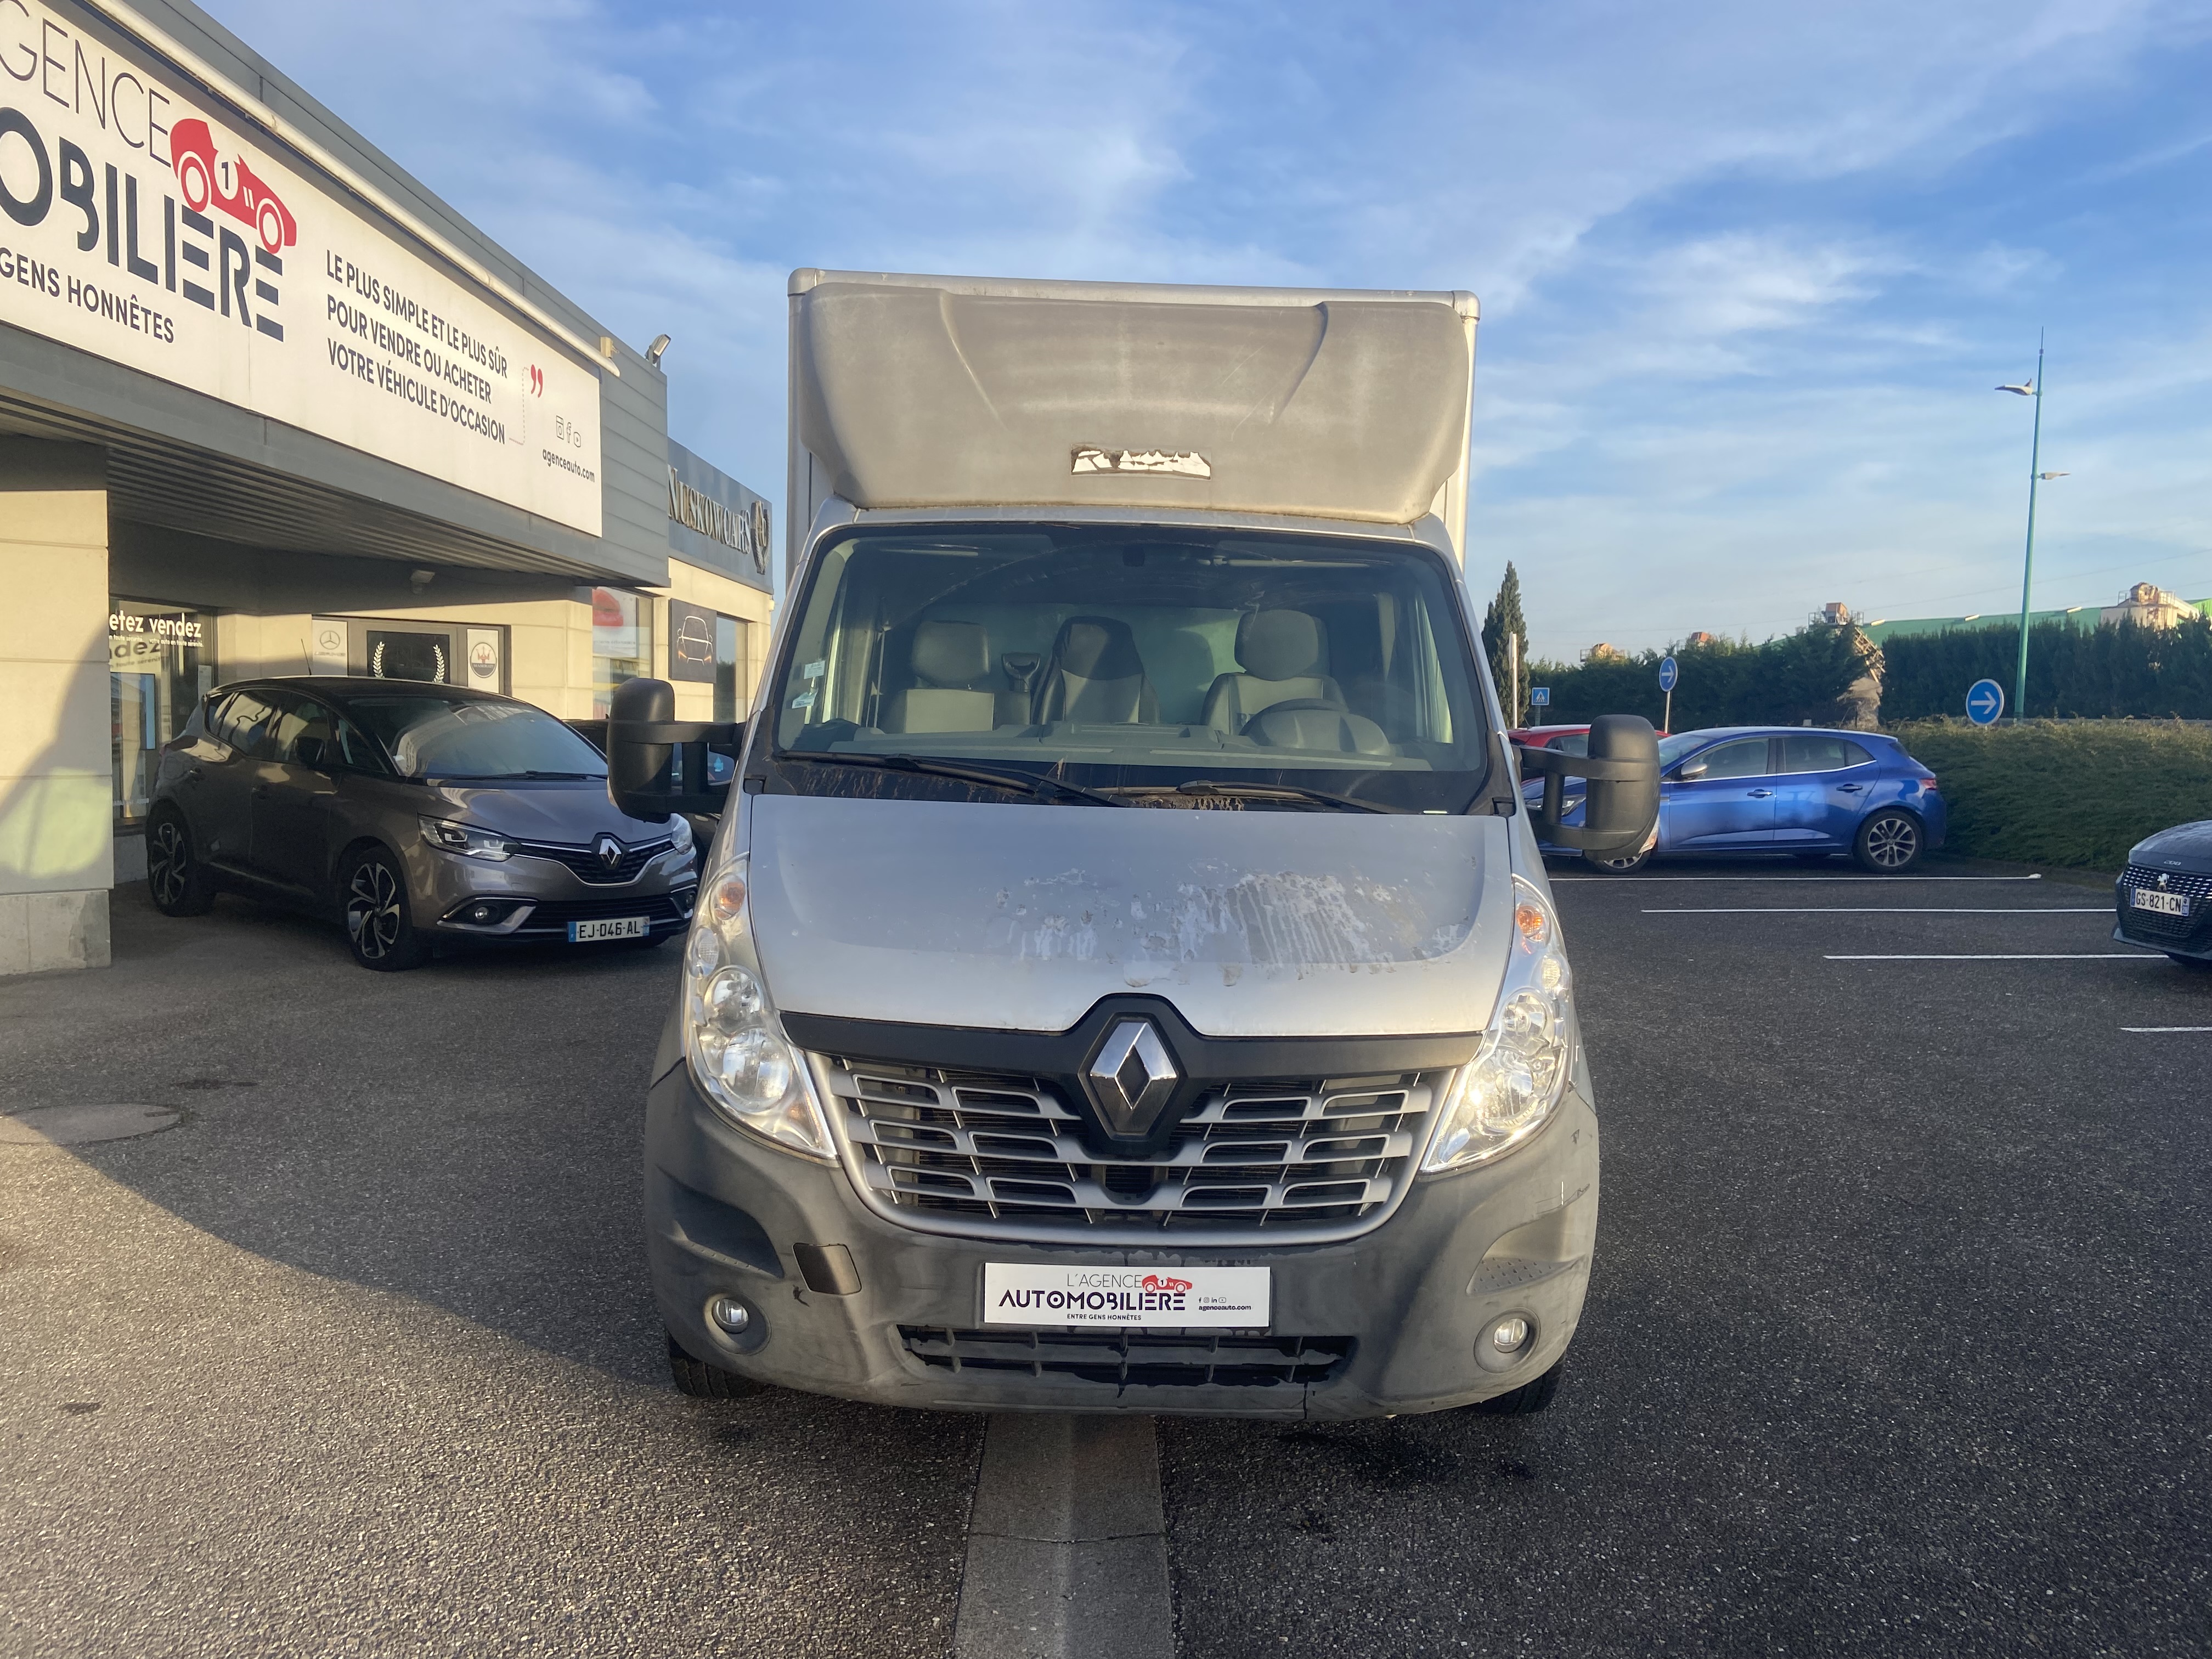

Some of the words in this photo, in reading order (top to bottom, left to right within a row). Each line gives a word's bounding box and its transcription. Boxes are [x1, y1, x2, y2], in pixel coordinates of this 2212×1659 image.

[0, 247, 60, 297] GENS
[67, 275, 174, 343] HONNÊTES
[327, 249, 343, 284] LE
[346, 261, 380, 304] PLUS
[383, 285, 429, 334] SIMPLE
[432, 313, 445, 342] ET
[447, 323, 459, 351] LE
[461, 331, 487, 366] PLUS
[488, 346, 507, 379] SÛR
[327, 294, 368, 340] POUR
[370, 317, 421, 368] VENDRE
[424, 348, 441, 377] OU
[443, 359, 492, 404] ACHETER
[327, 337, 374, 385] VOTRE
[376, 359, 438, 414] VÉHICULE
[439, 393, 505, 445] D'OCCASION
[542, 448, 595, 483] agenceauto.com
[109, 610, 144, 633] etez
[149, 612, 202, 638] vendez
[2136, 891, 2181, 913] GS-821-CN
[579, 921, 641, 939] EJ-046-AL
[1067, 1273, 1142, 1288] L'AGENCE
